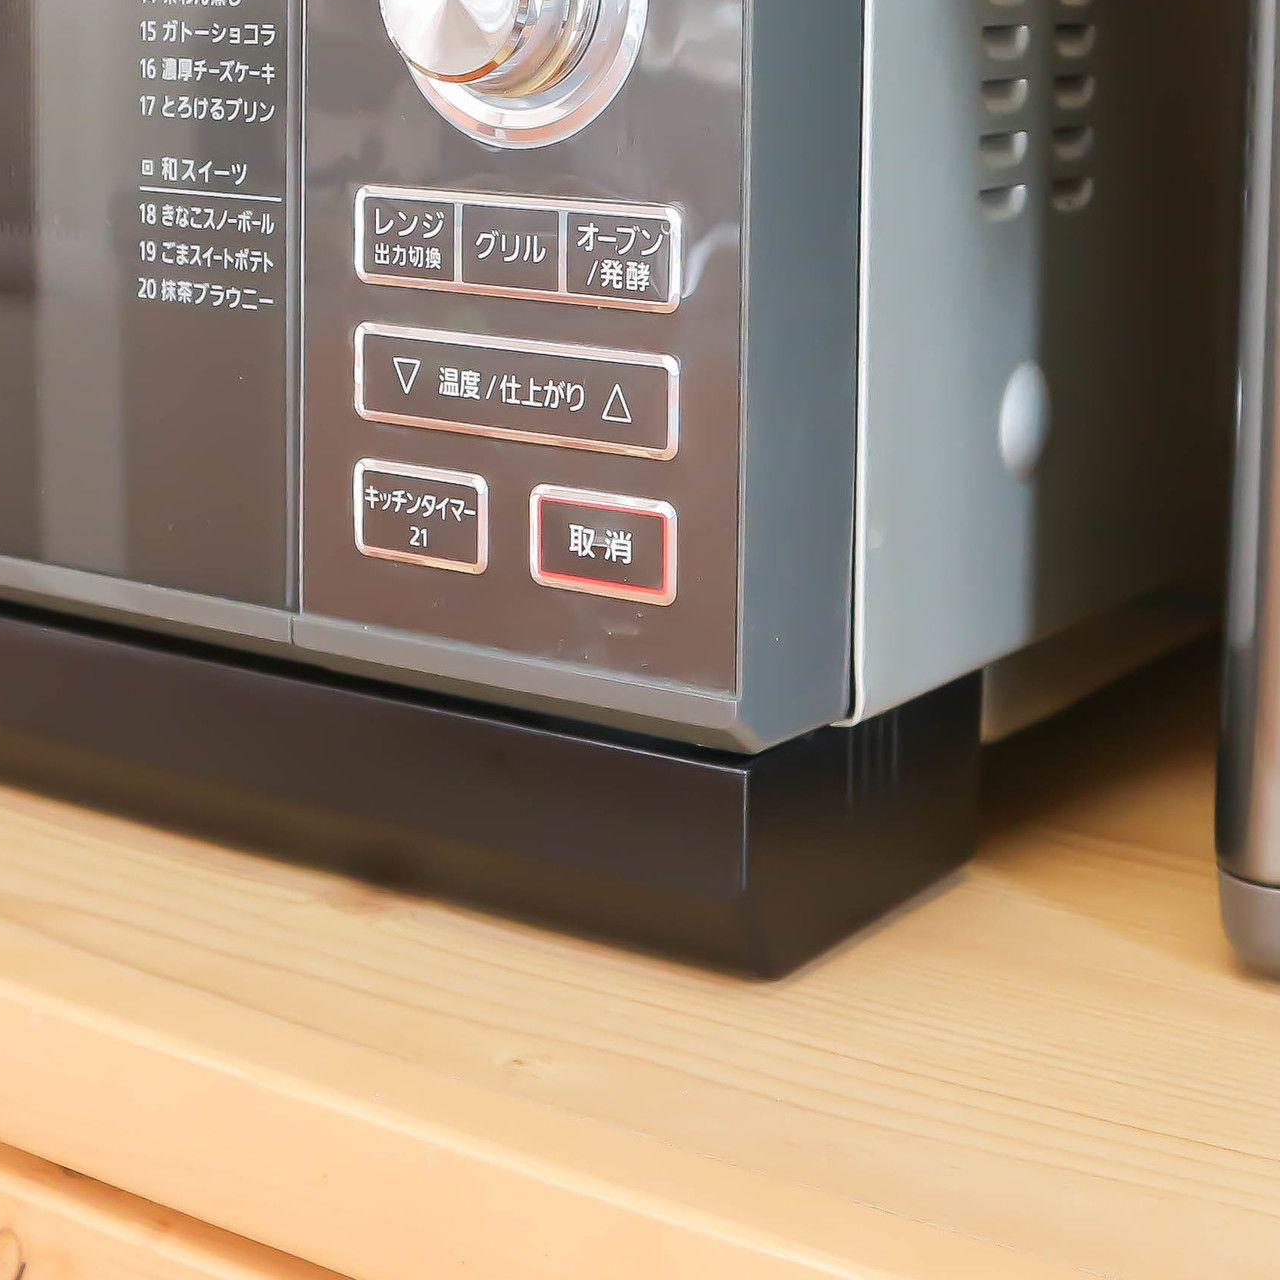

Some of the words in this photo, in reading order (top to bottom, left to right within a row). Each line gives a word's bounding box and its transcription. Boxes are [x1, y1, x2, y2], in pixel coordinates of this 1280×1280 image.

[140, 21, 156, 42] 15
[162, 20, 276, 46] ガトーショコラ
[140, 58, 156, 79] 16
[162, 58, 275, 84] 濃厚チーズケーキ
[140, 95, 155, 116] 17
[162, 95, 275, 122] とろけるプリン
[162, 156, 247, 185] 和スイーツ
[140, 204, 156, 225] 18
[162, 204, 275, 234] きなこスノーボール
[374, 208, 445, 240] レンジ
[475, 231, 547, 264] グリル
[576, 223, 664, 256] オーブン
[140, 241, 156, 262] 19
[162, 242, 274, 273] ごまスイートポテト
[374, 245, 442, 270] 出力切換
[137, 277, 156, 299] 20
[161, 279, 274, 310] 抹茶ブラウニー
[364, 486, 476, 522] キッチンタイマー
[409, 527, 428, 548] 21
[569, 524, 633, 564] 取消
